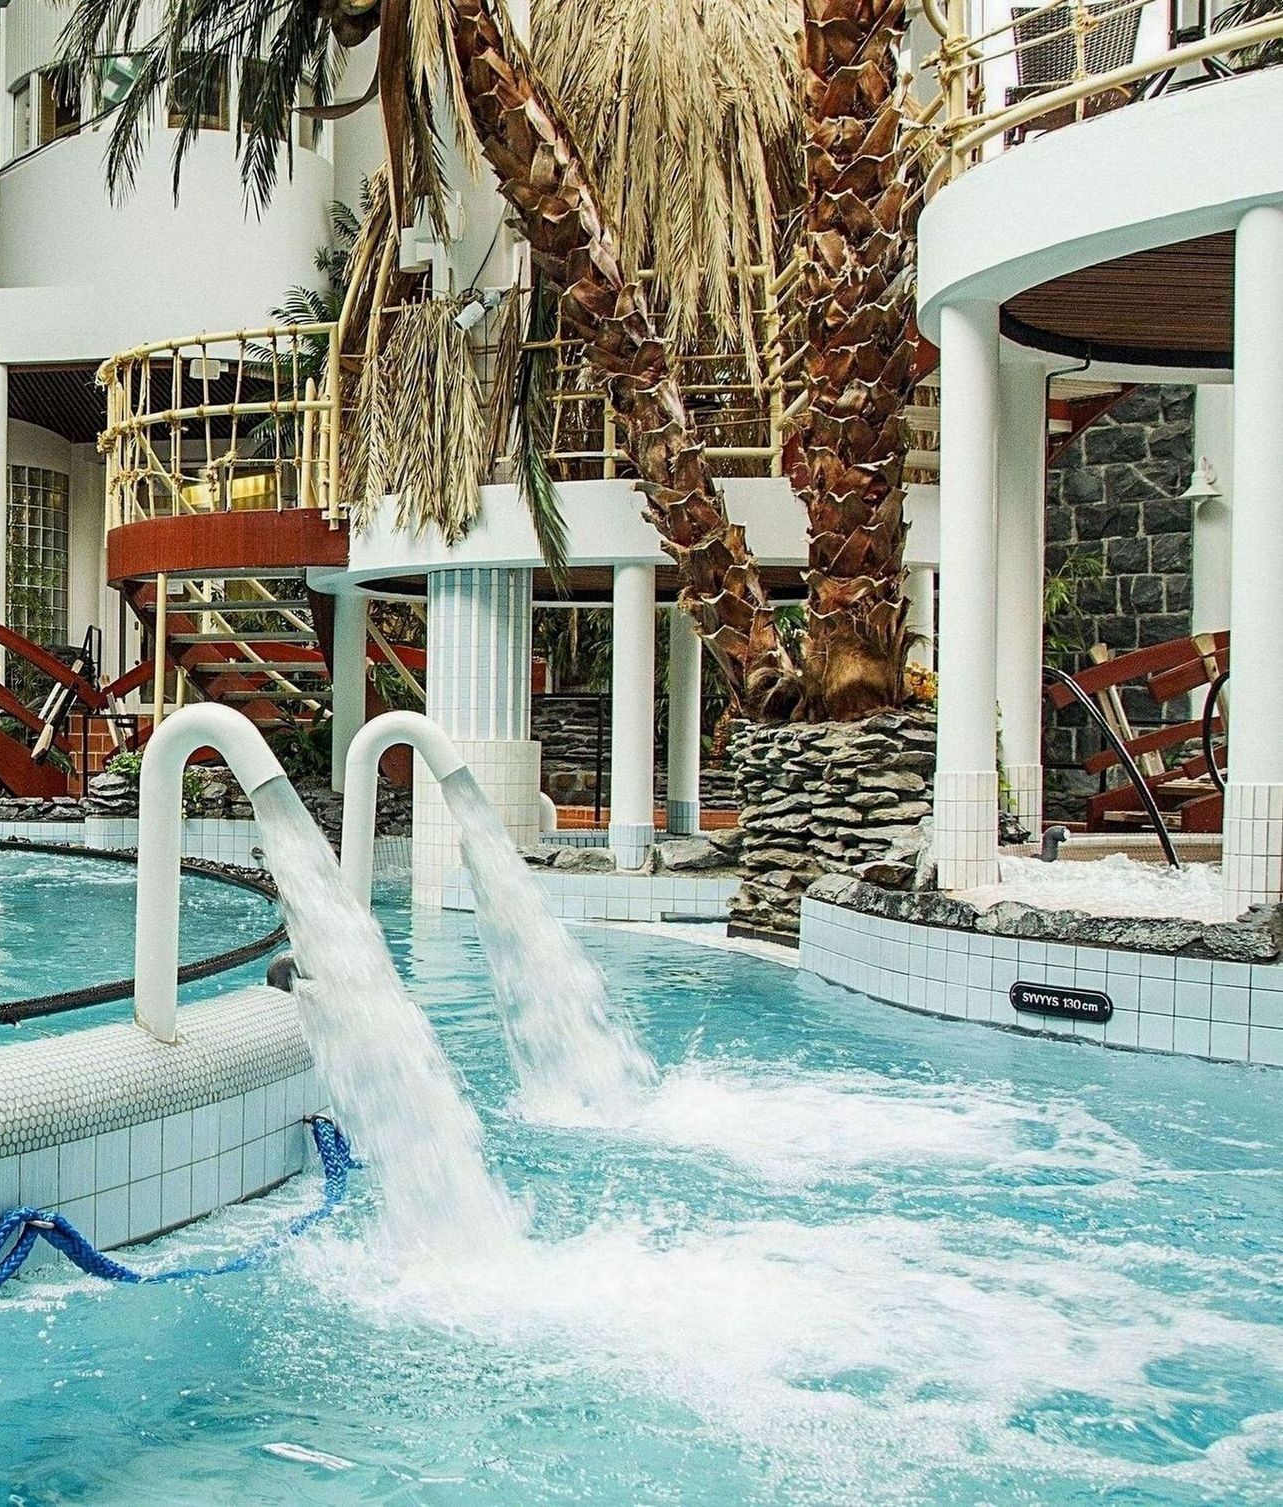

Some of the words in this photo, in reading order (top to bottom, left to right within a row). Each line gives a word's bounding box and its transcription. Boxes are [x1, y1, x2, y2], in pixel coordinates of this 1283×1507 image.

[1022, 992, 1059, 1007] SYVYYS
[1062, 997, 1081, 1010] 130
[1082, 1003, 1098, 1012] cm
